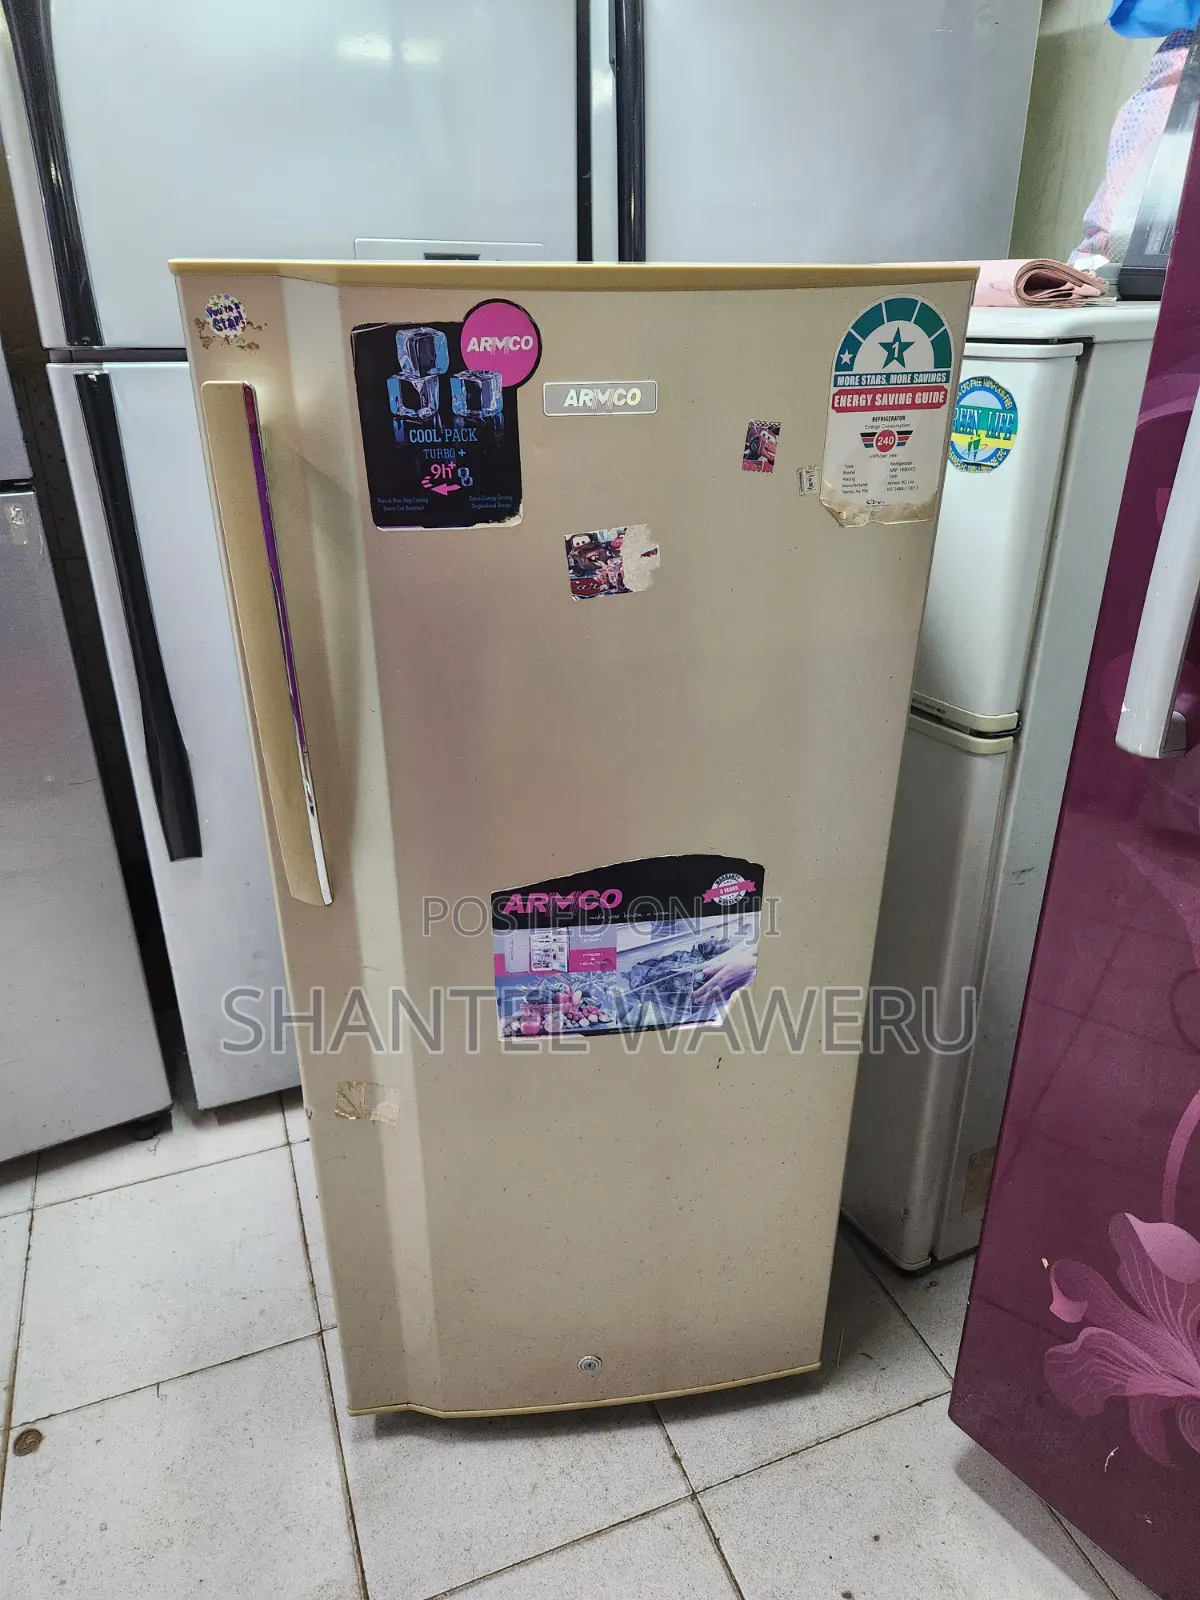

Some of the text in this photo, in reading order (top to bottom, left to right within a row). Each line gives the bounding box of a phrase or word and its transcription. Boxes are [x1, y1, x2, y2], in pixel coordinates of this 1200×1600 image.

[466, 335, 534, 354] ARMCO
[892, 341, 899, 358] 1
[837, 372, 947, 386] MORE STARS, MORE SAVINGS
[563, 387, 643, 411] ARMCO
[834, 393, 873, 408] ENERGY
[874, 392, 913, 406] SAVING
[915, 391, 946, 404] GUIDE
[954, 407, 1014, 439] REEN LIFE
[409, 428, 478, 443] COOL PACK
[877, 435, 895, 446] 240
[423, 448, 455, 459] TURBO
[501, 888, 623, 915] ARMCO
